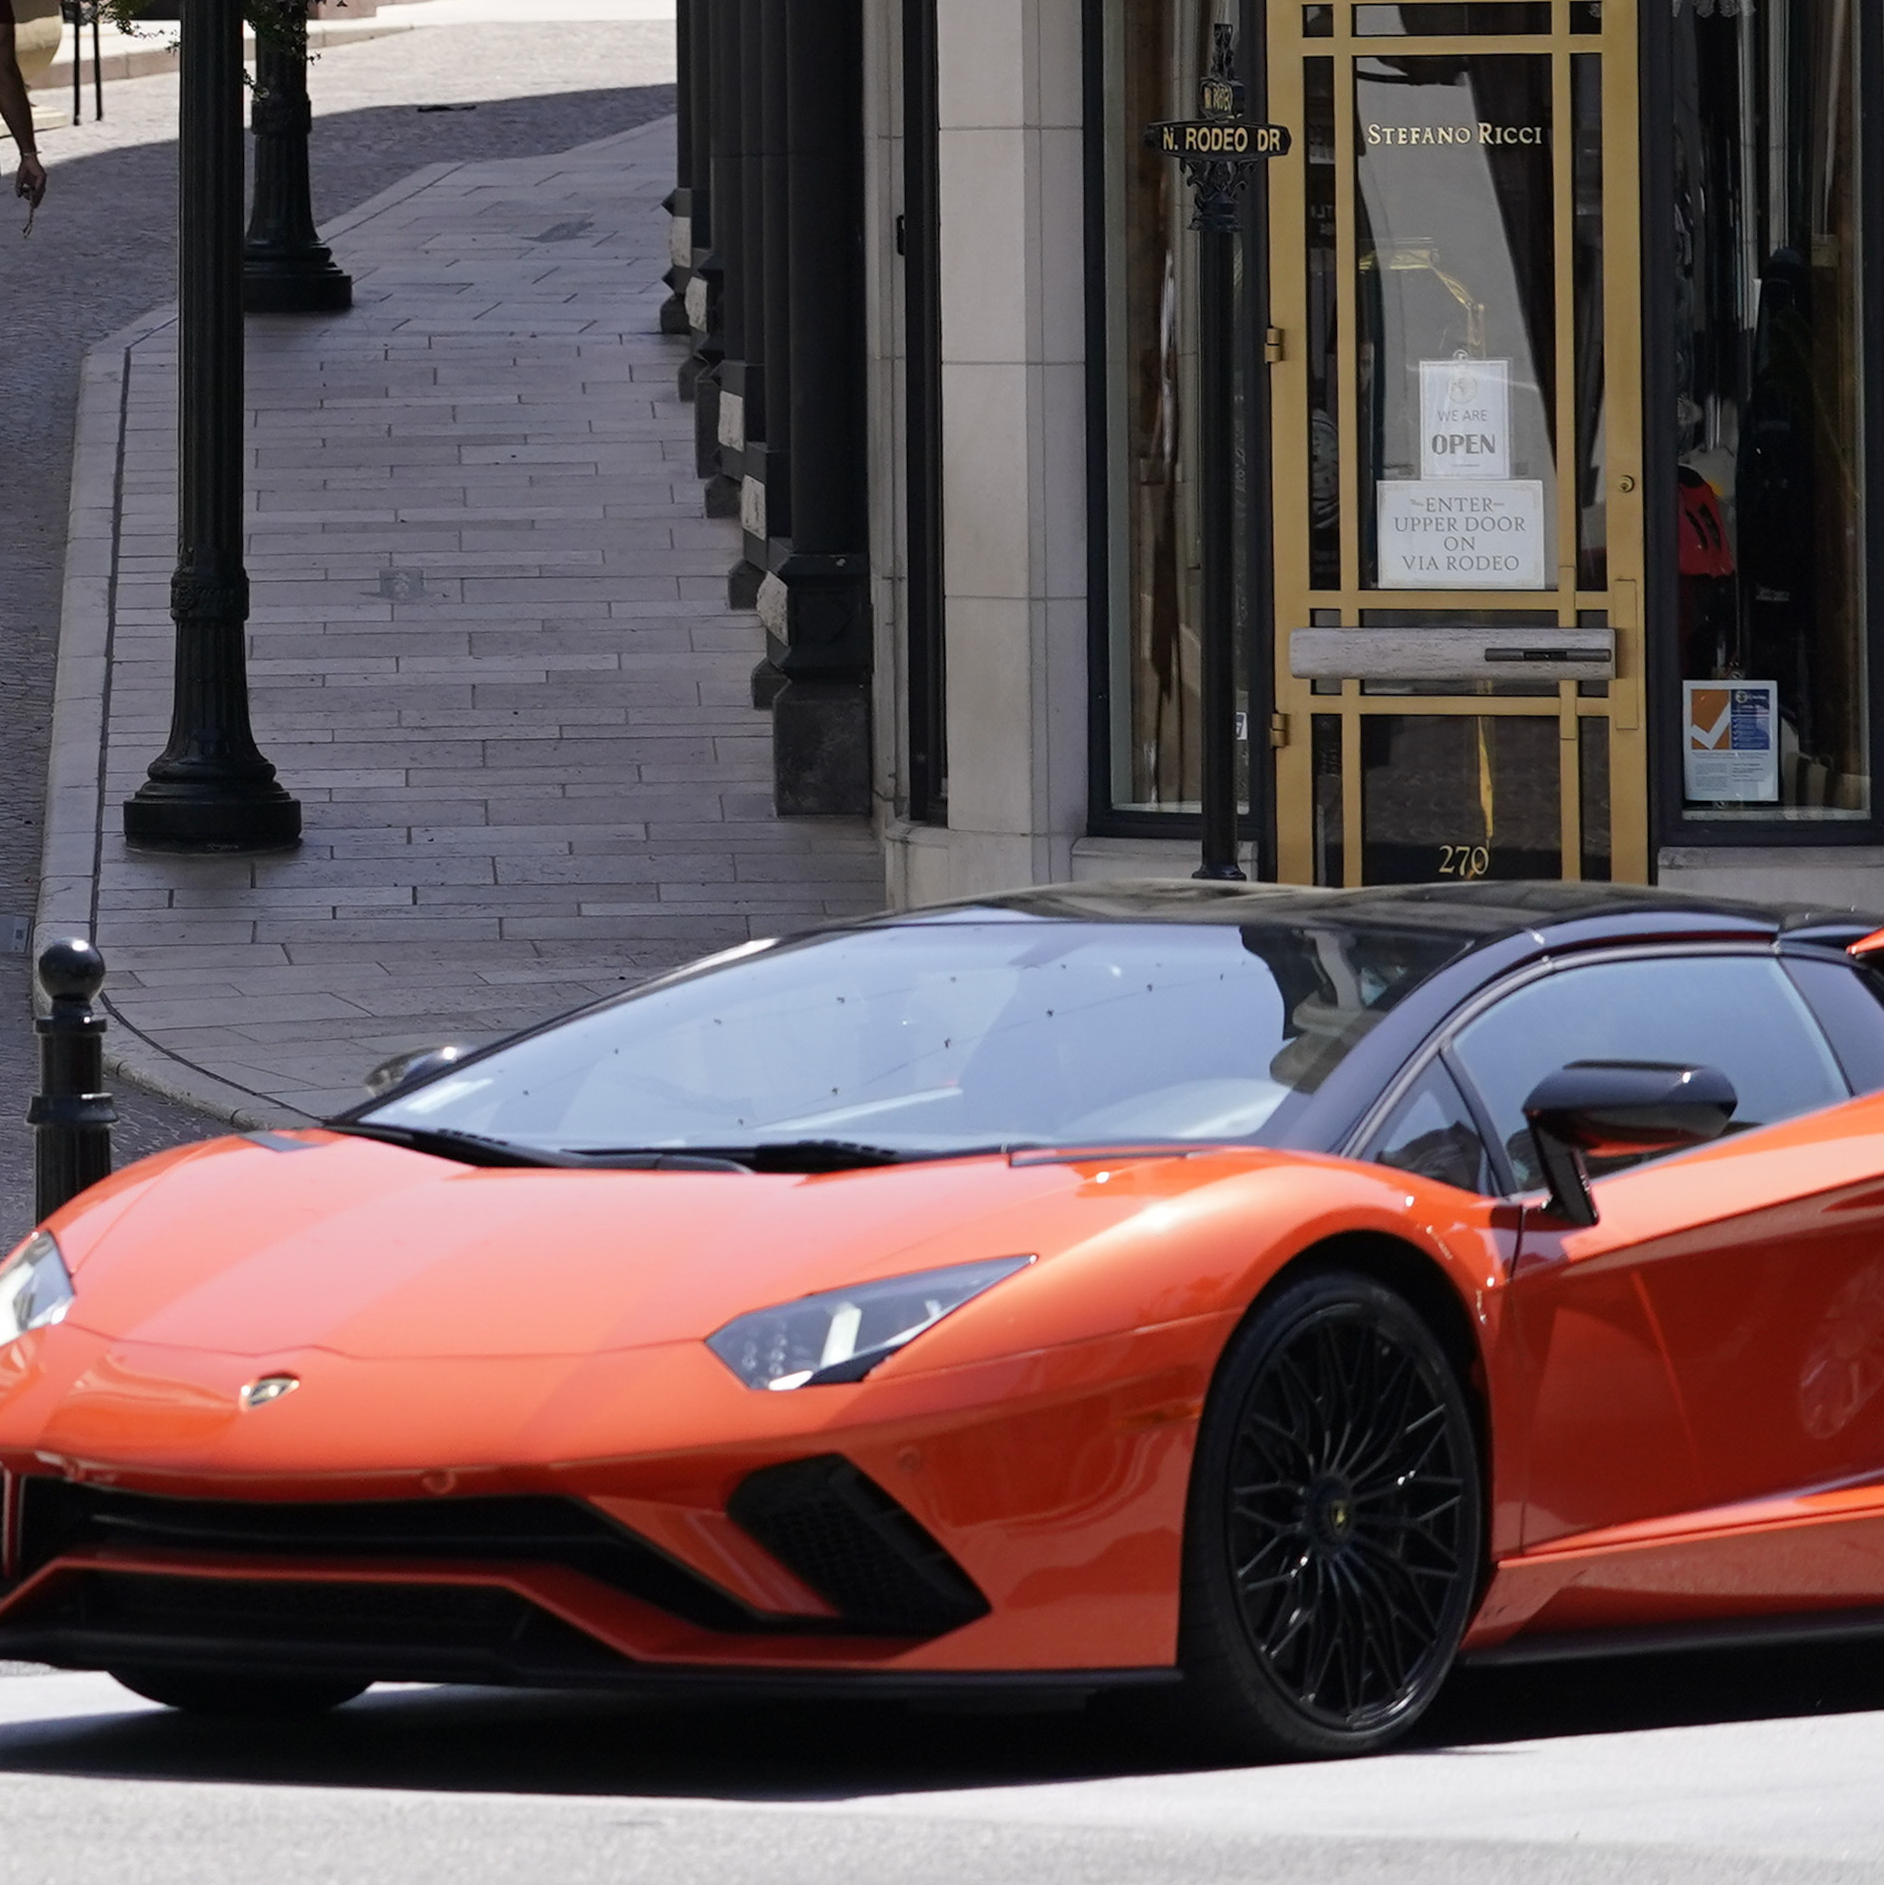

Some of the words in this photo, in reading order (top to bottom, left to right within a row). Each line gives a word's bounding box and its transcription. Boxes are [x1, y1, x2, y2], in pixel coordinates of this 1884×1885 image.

[1162, 127, 1179, 151] N.
[1185, 127, 1249, 152] RODEO
[1256, 128, 1281, 151] DR
[1367, 123, 1471, 145] STEFANO
[1477, 122, 1543, 145] RICCI
[1437, 408, 1459, 422] WE
[1462, 408, 1488, 422] ARE
[1432, 434, 1495, 455] OPEN
[1394, 517, 1459, 532] UPPER
[1465, 516, 1527, 532] DOOR
[1443, 535, 1476, 552] ON
[1401, 555, 1440, 571] VIA
[1446, 555, 1520, 572] RODEO
[1438, 845, 1490, 876] 270
